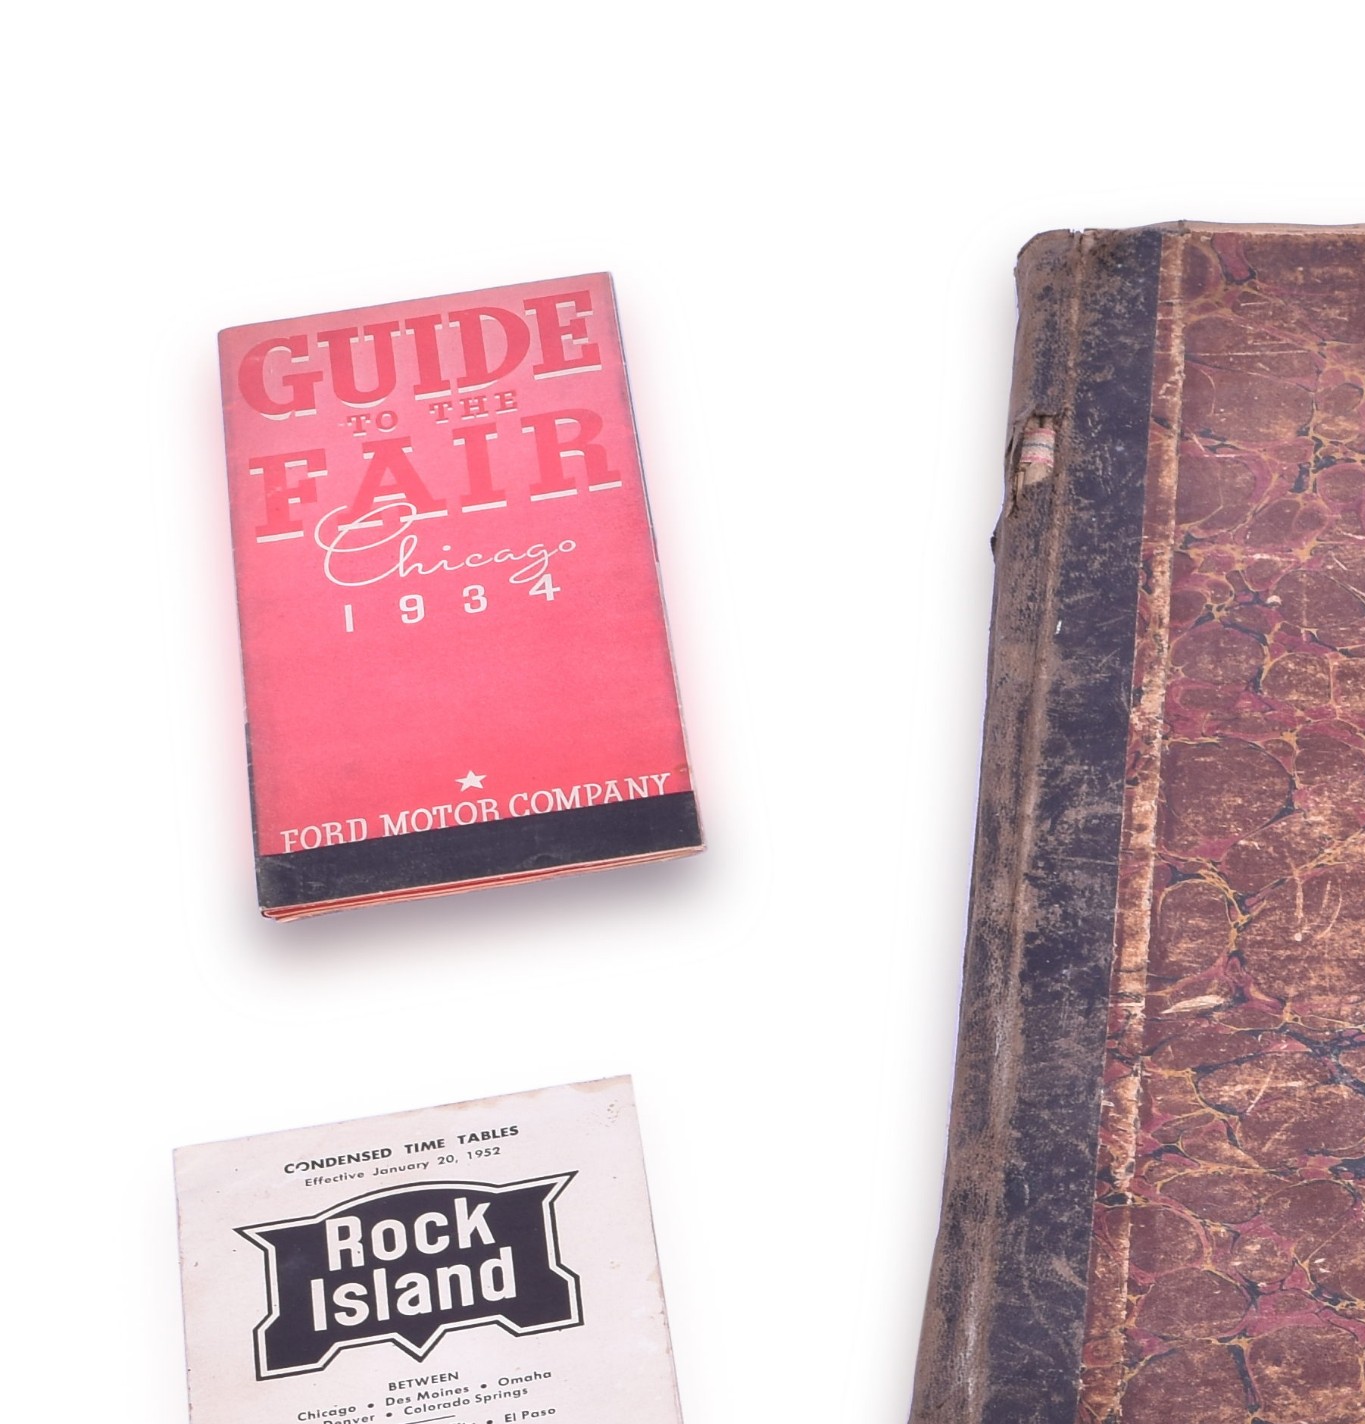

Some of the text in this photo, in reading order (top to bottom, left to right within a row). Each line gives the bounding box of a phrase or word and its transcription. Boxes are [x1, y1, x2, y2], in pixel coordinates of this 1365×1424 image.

[237, 290, 602, 421] GUIDE
[345, 388, 519, 437] TO THE
[249, 408, 622, 543] FAIR
[314, 501, 577, 587] Chicago
[344, 573, 561, 633] 1934
[280, 771, 672, 855] FORD MOTOR COMPANY
[282, 1124, 519, 1174] CONDENSED TIME TABLES
[303, 1145, 501, 1187] Effective January 20, 1952
[324, 1197, 496, 1271] Rock
[310, 1246, 517, 1332] Island
[296, 1370, 552, 1422] Chicago Des Moines Omaha
[387, 1370, 459, 1392] BETWEEN
[402, 1396, 471, 1416] Colorado
[473, 1387, 528, 1404] Springs
[503, 1411, 517, 1423] El
[520, 1407, 556, 1420] Paso
